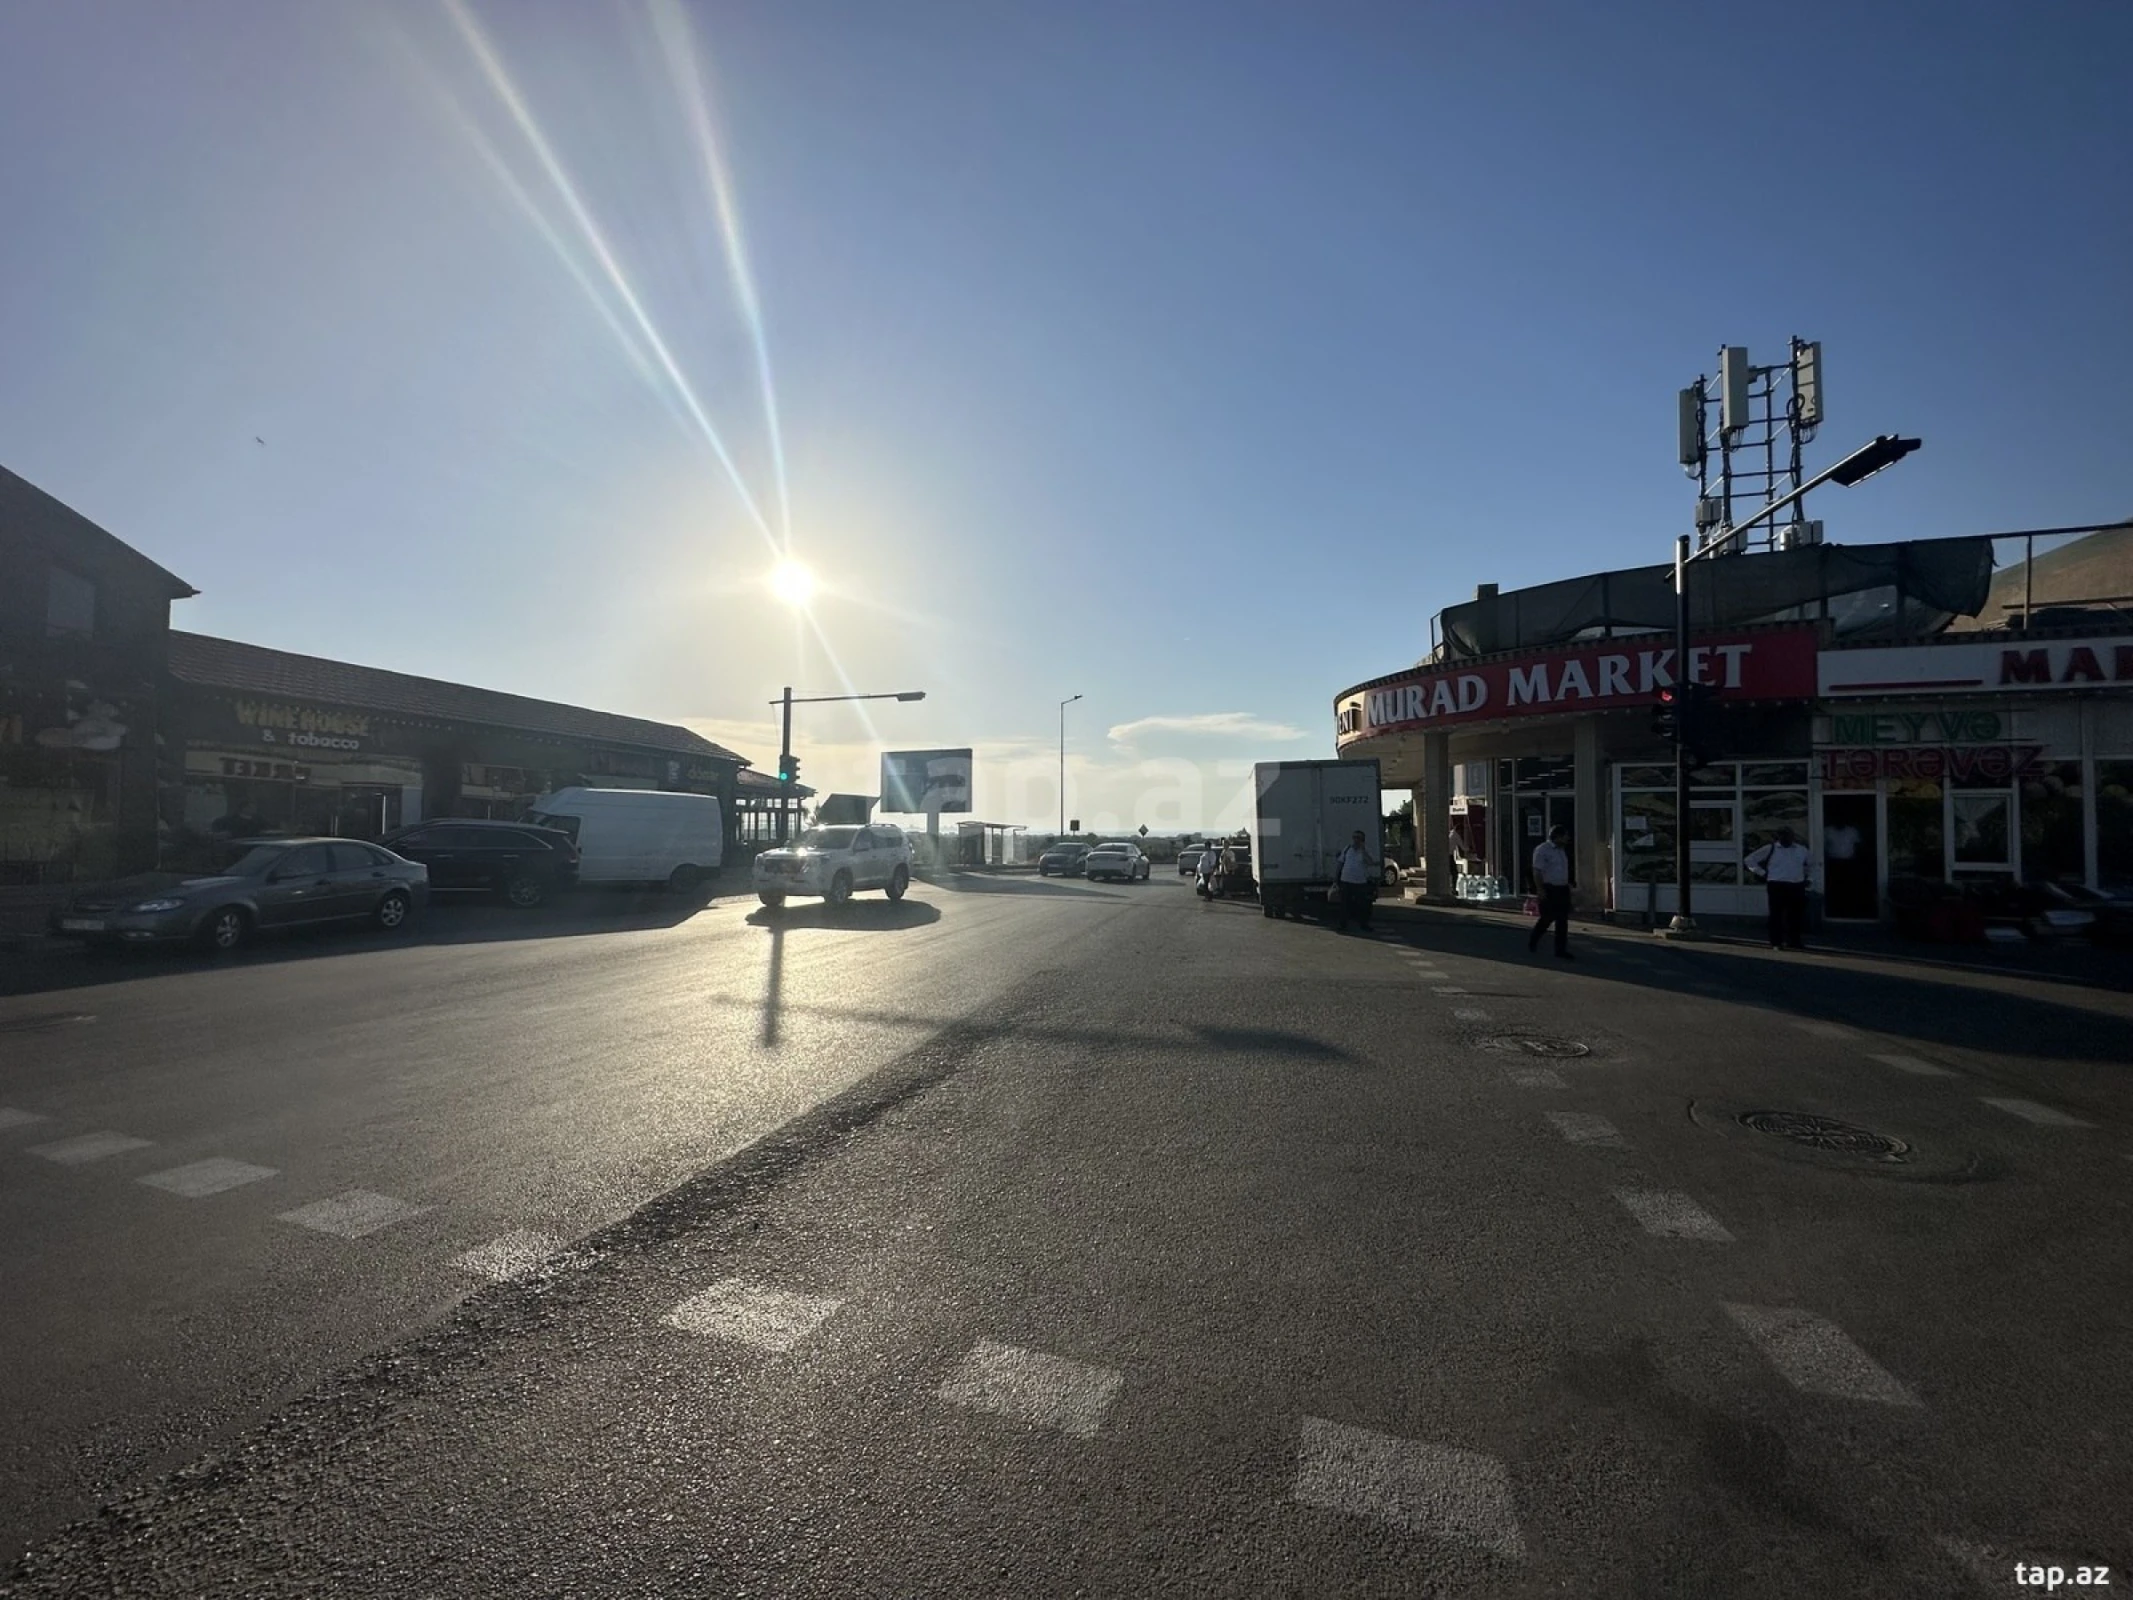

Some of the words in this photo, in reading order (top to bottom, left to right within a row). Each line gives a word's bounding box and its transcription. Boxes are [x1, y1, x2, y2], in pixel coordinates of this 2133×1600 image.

[1366, 674, 1488, 728] MURAD
[1506, 643, 1752, 708] MARKET
[262, 729, 275, 743] &
[287, 730, 360, 750] tobacco
[1833, 710, 2002, 744] MEYVƏ
[1823, 746, 2046, 783] TƏRƏVƏZ
